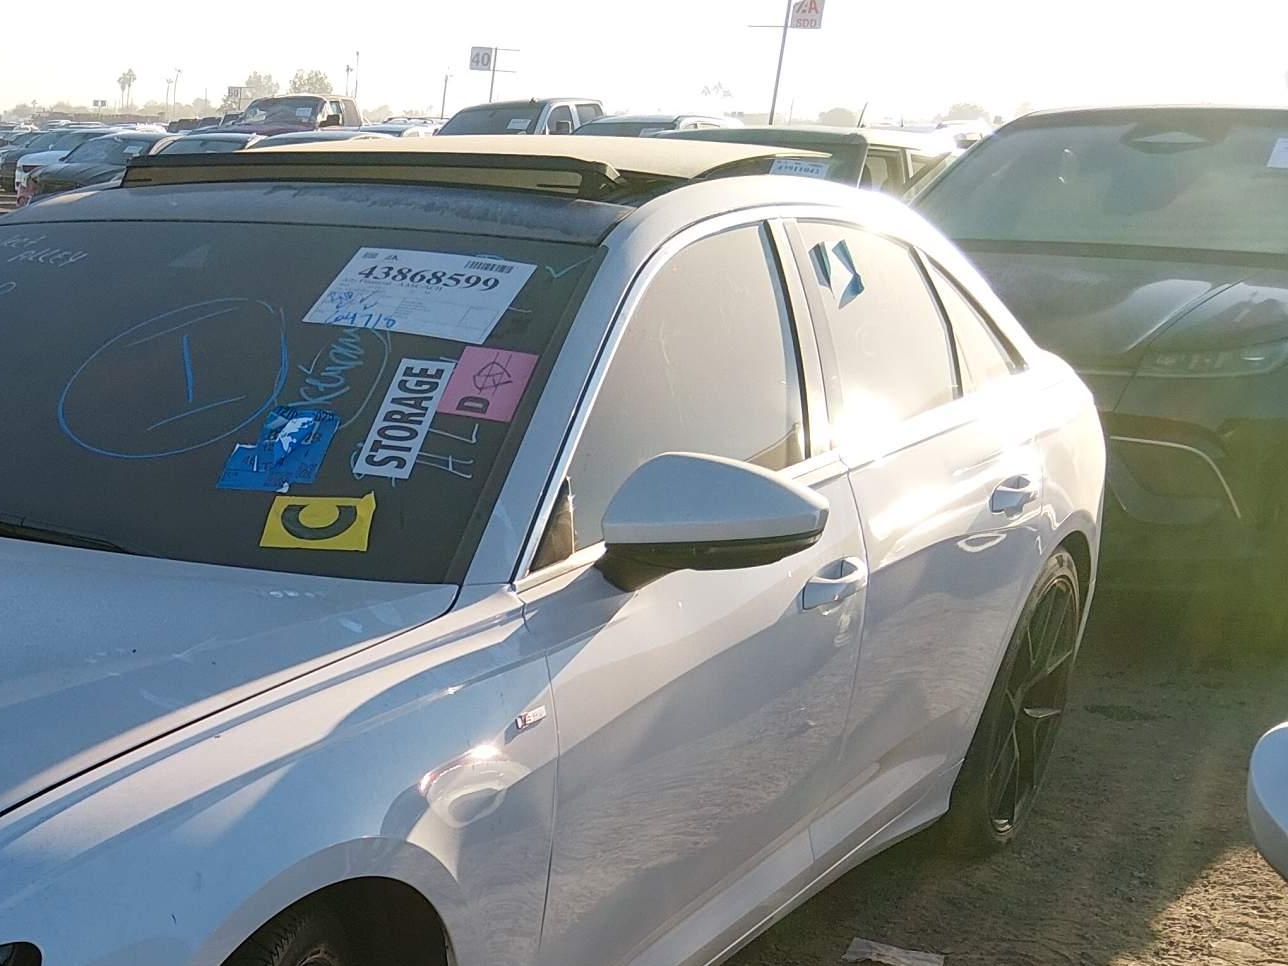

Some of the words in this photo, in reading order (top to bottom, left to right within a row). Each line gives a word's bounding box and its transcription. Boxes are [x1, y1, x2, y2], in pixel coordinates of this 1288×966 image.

[472, 52, 489, 66] 40
[358, 265, 500, 292] 43868599
[364, 366, 446, 470] STORAGE
[455, 396, 490, 414] D
[280, 504, 358, 540] C
